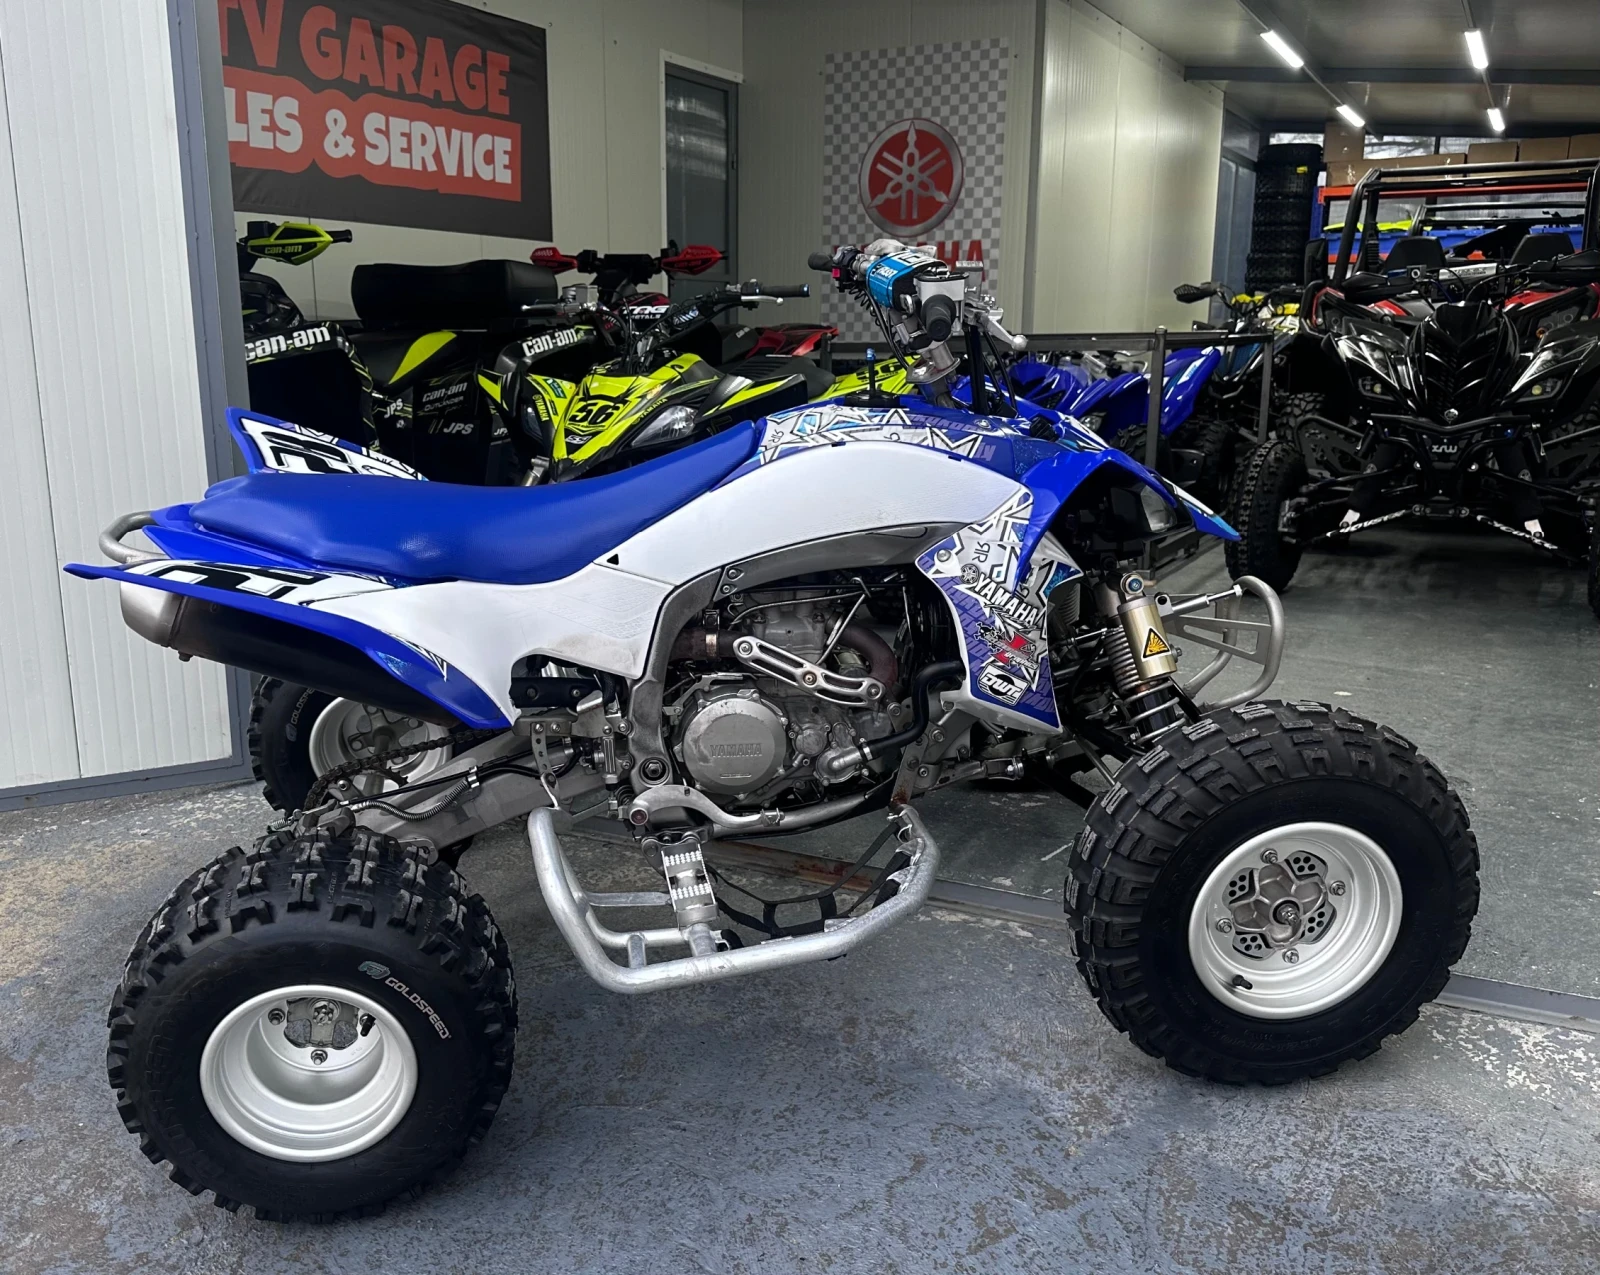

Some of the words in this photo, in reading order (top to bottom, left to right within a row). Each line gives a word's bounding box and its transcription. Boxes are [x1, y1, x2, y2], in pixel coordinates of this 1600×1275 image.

[299, 5, 510, 115] GARAGE
[323, 109, 355, 159] &
[364, 112, 512, 184] SERVICE
[264, 244, 302, 254] can-am
[622, 305, 670, 315] TAG
[245, 325, 331, 361] can-am
[522, 328, 577, 358] can-am
[422, 382, 467, 402] can-am
[424, 396, 464, 411] OUTLANDER
[384, 399, 404, 419] JPS
[534, 396, 549, 422] YAMAHA
[570, 402, 620, 425] 56
[638, 398, 669, 420] YAMAHA
[443, 421, 474, 436] JPS
[974, 572, 1038, 627] YAMAHA
[981, 673, 1022, 699] DWT
[710, 743, 763, 758] YAMAHA
[385, 976, 448, 1039] GOLDSPEED
